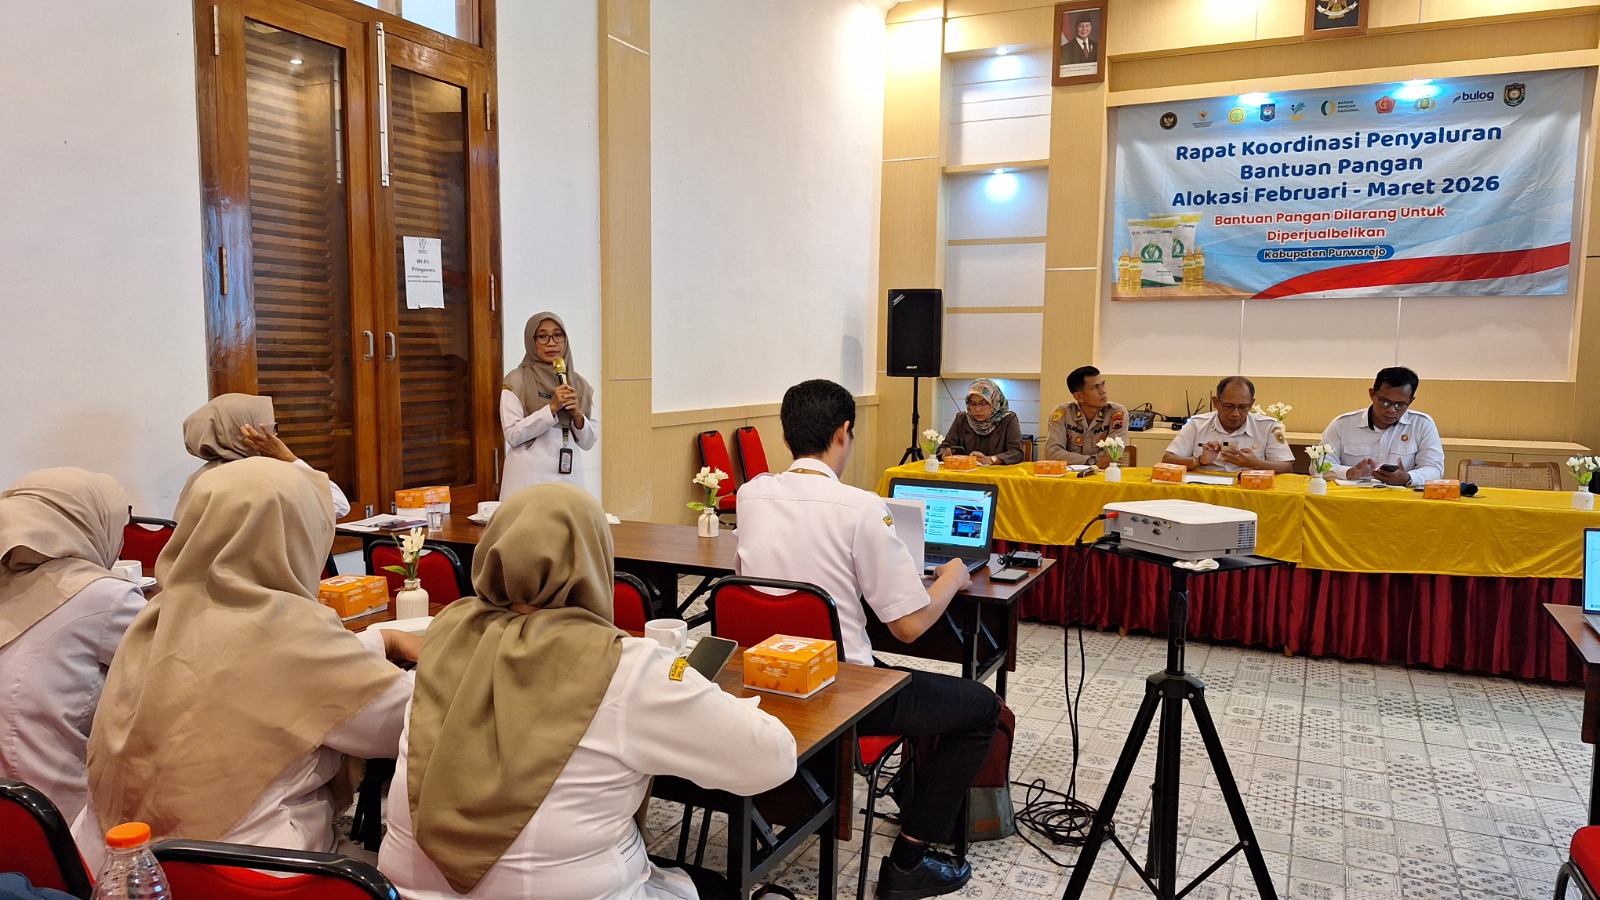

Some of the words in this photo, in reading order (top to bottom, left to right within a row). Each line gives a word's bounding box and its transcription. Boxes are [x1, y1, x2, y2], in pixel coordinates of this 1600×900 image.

[1462, 91, 1494, 101] bulog
[1176, 142, 1236, 163] Rapat
[1241, 131, 1361, 156] Koordinasi
[1366, 126, 1502, 150] Penyaluran
[1240, 161, 1331, 180] Bantuan
[1338, 157, 1423, 176] Pangan
[1172, 186, 1249, 207] Alokasi
[1254, 181, 1347, 203] Februari
[1367, 179, 1435, 197] Maret
[1441, 175, 1500, 194] 2026
[1215, 214, 1273, 226] Bantuan
[1276, 211, 1331, 225] Pangan
[1334, 208, 1397, 222] Dilarang
[1400, 205, 1446, 218] Untuk
[1266, 227, 1386, 244] Diperjualbelikan
[1264, 249, 1326, 261] Kabupaten
[1328, 246, 1386, 259] Purworejo
